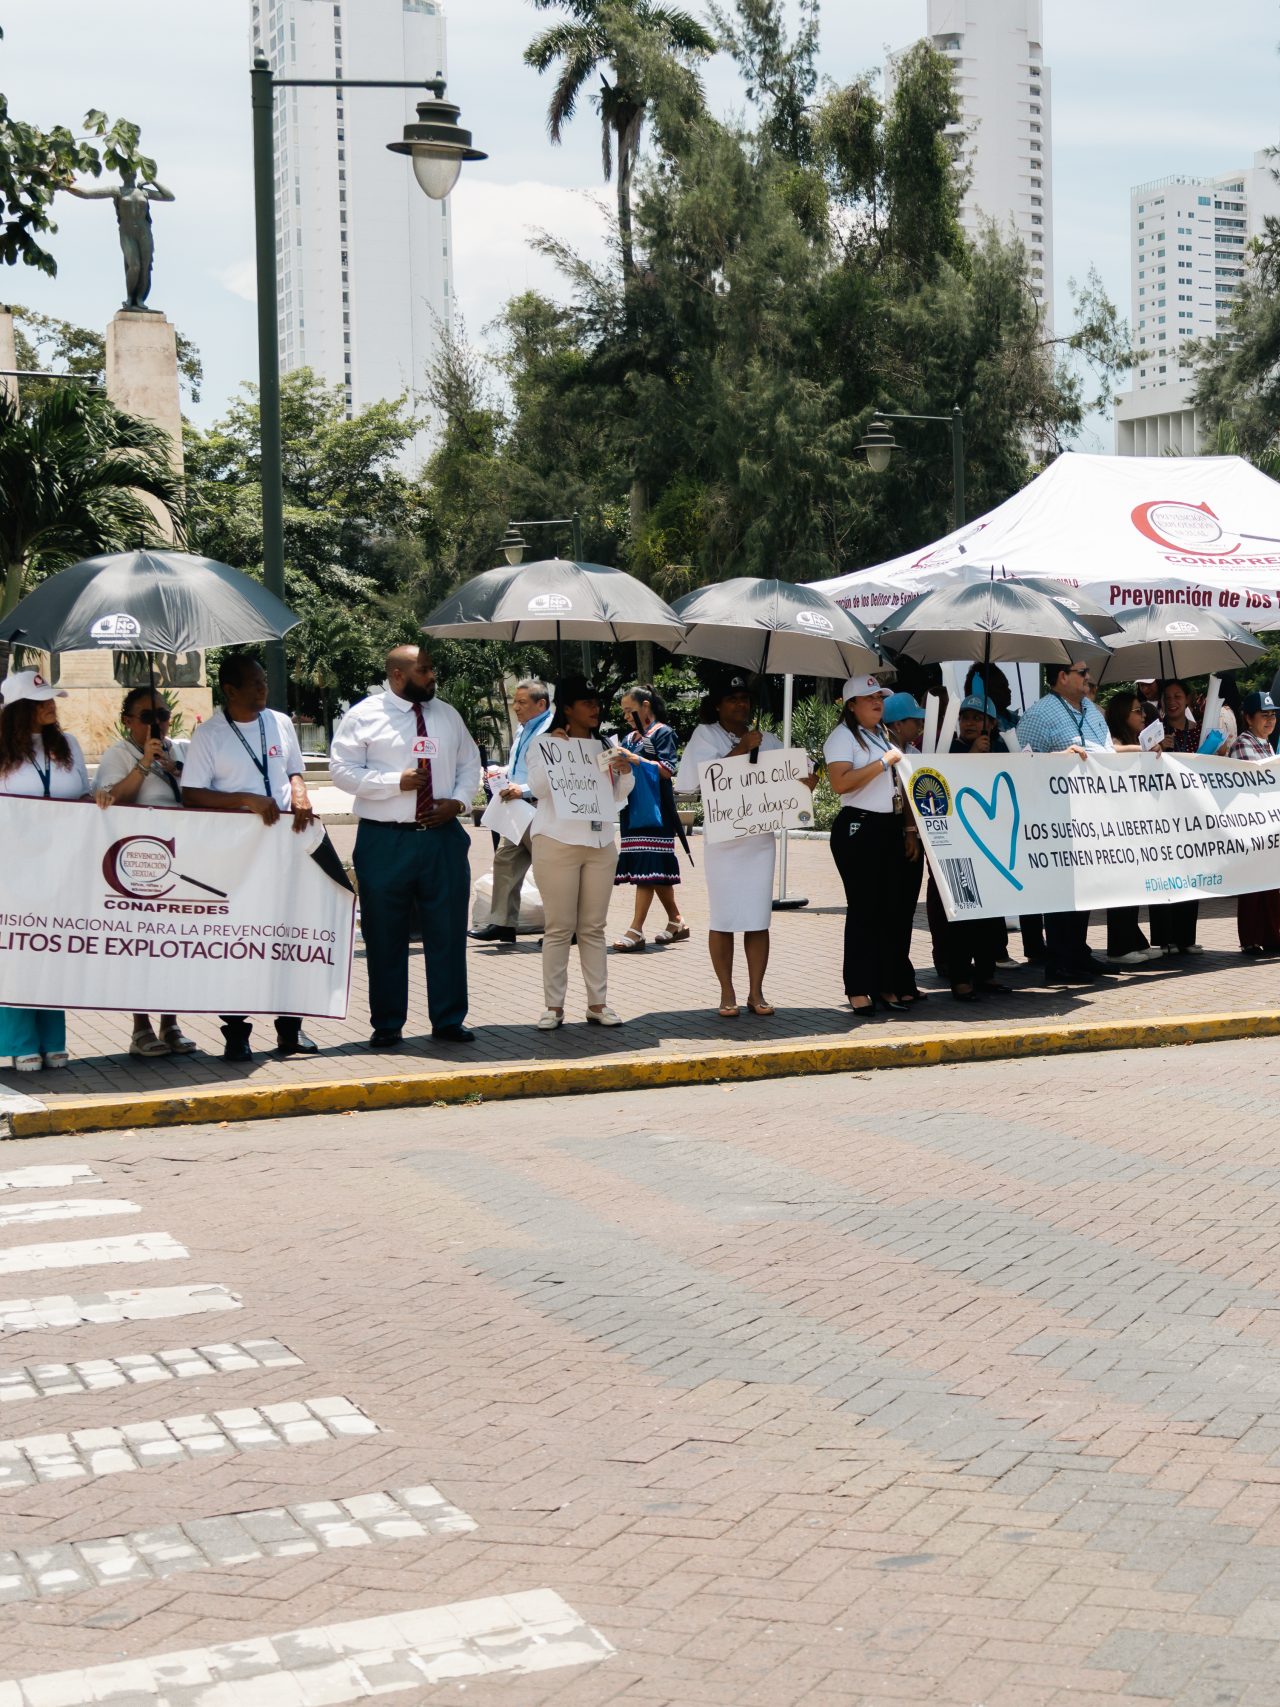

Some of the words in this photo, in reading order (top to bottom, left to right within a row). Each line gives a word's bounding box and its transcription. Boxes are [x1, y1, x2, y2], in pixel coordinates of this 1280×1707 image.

[1110, 584, 1212, 607] Prevención
[1218, 588, 1240, 607] de
[1246, 590, 1272, 608] los
[539, 741, 562, 765] NO
[568, 751, 575, 764] a
[578, 740, 592, 765] la
[548, 766, 598, 798] Explotación
[705, 763, 733, 792] Por
[740, 769, 768, 787] una
[771, 760, 800, 782] calle
[1050, 775, 1107, 795] CONTRA
[1109, 775, 1128, 793] LA
[1129, 773, 1177, 792] TRATA
[1180, 772, 1199, 789] DE
[1201, 769, 1276, 789] PERSONAS
[569, 793, 600, 814] Sexual
[707, 799, 735, 823] libre
[738, 794, 753, 818] de
[759, 792, 798, 814] abuso
[733, 812, 787, 838] Sexual
[925, 820, 949, 831] PGN
[1024, 824, 1048, 840] LOS
[1052, 818, 1099, 840] SUEÑOS,
[1100, 822, 1116, 837] LA
[1116, 819, 1171, 836] LIBERTAD
[1172, 818, 1181, 833] Y
[1185, 816, 1202, 832] LA
[1206, 811, 1266, 830] DIGNIDAD
[126, 852, 166, 860] PREVENCIÓN
[1028, 852, 1048, 869] NO
[1051, 850, 1093, 867] TIENEN
[1095, 847, 1139, 866] PRECIO,
[1140, 846, 1158, 862] NO
[1161, 845, 1174, 860] SE
[1176, 838, 1249, 860] COMPRAN,
[1252, 836, 1265, 851] NI
[1268, 833, 1280, 849] SE
[123, 860, 167, 869] EXPLOTACIÓN
[104, 900, 229, 915] CONAPREDES
[52, 916, 132, 932] NACIONAL
[137, 922, 176, 934] PARA
[181, 924, 199, 936] LA
[203, 923, 290, 938] PREVENCIÓN
[291, 927, 308, 939] DE
[313, 929, 336, 942] LOS
[68, 935, 98, 954] DE
[105, 937, 265, 959] EXPLOTACIÓN
[271, 943, 335, 965] SEXUAL
